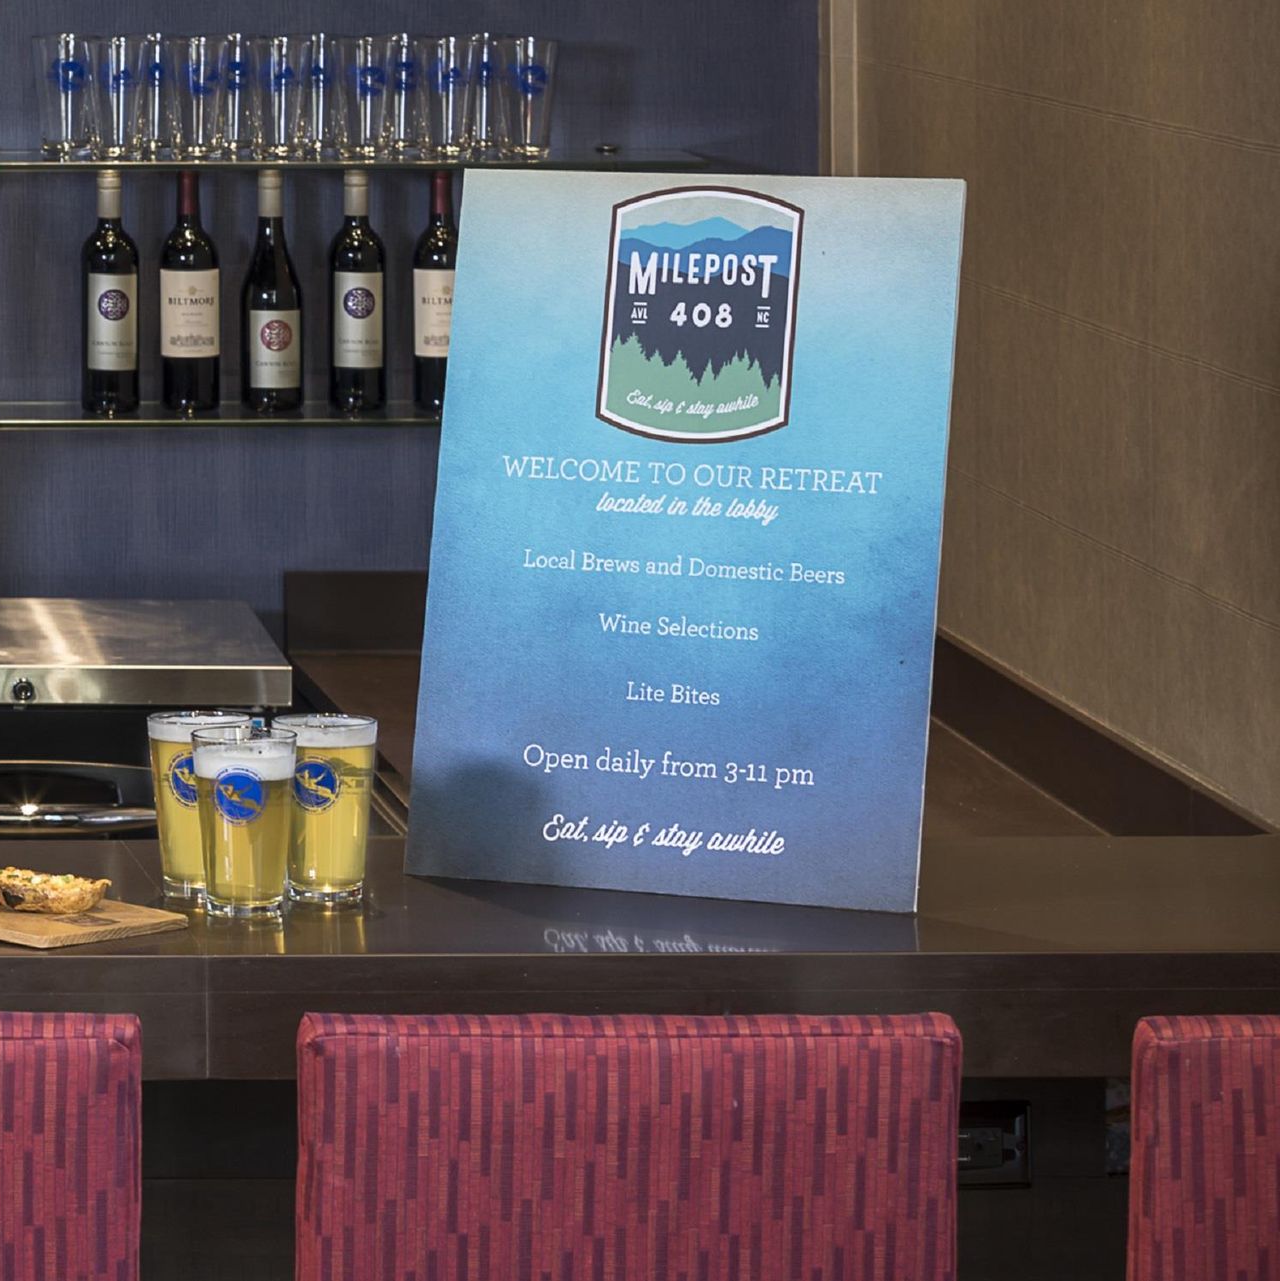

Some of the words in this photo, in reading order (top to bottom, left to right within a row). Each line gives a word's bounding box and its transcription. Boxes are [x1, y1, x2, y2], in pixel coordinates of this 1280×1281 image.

[628, 251, 778, 298] MILEPOST
[421, 296, 453, 306] BILTM
[631, 307, 648, 320] AVL
[669, 302, 733, 328] 408
[757, 311, 770, 324] NC
[626, 389, 653, 409] Eat,
[653, 399, 674, 414] sip
[686, 400, 715, 419] stay
[716, 393, 759, 414] awhile
[502, 455, 641, 483] WELCOME
[648, 462, 686, 485] TO
[693, 464, 753, 488] OUR
[760, 467, 883, 494] RETREAT
[595, 491, 667, 514] located
[667, 496, 688, 515] in
[692, 495, 723, 517] the
[725, 498, 779, 526] lobby
[523, 549, 576, 571] Local
[581, 552, 640, 574] Brews
[645, 556, 683, 577] and
[688, 557, 784, 582] Domestic
[789, 563, 845, 585] Beers
[598, 612, 652, 635] Wine
[656, 616, 759, 641] Selections
[626, 681, 666, 702] Lite
[670, 684, 720, 706] Bites
[523, 744, 589, 774] Open
[595, 748, 656, 779] daily
[661, 751, 717, 779] from
[723, 761, 767, 784] 3-11
[775, 767, 815, 790] pm
[542, 814, 588, 842] Eat,
[592, 819, 629, 847] sip
[633, 820, 652, 847] &
[652, 823, 705, 856] stay
[707, 828, 785, 855] awhile
